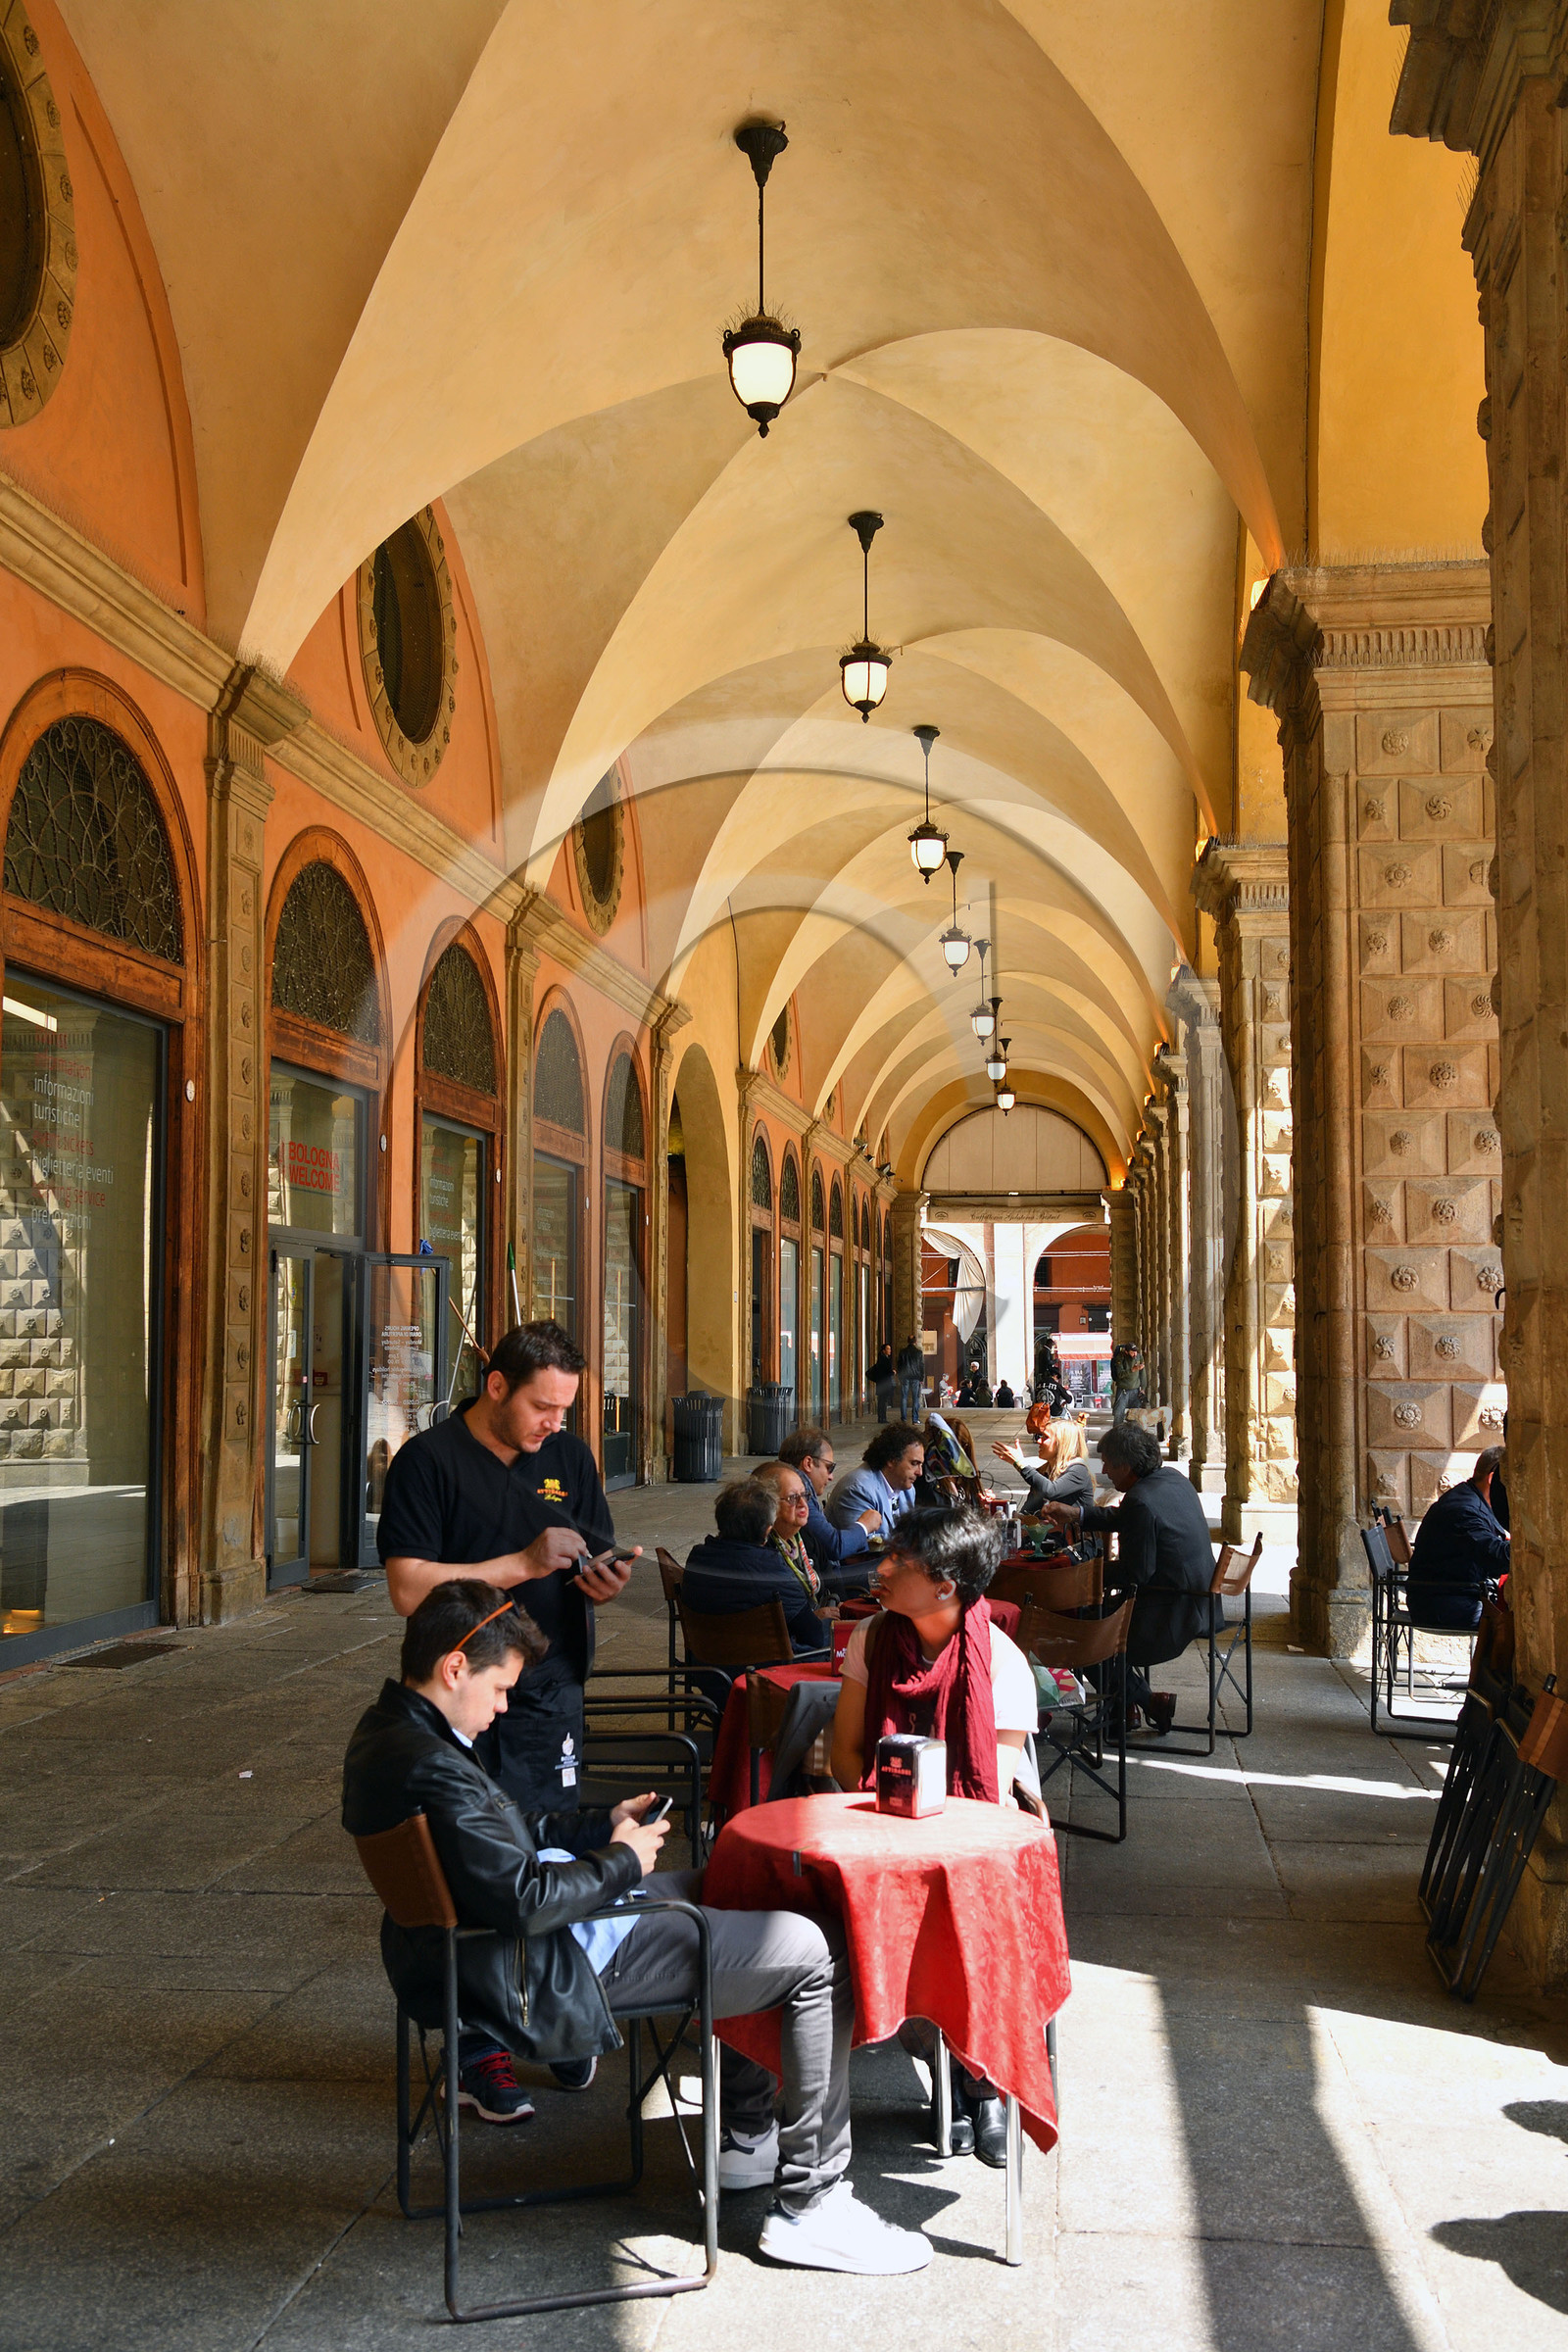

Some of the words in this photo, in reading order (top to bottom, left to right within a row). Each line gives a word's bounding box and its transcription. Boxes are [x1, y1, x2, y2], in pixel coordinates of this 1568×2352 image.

[34, 1072, 94, 1105] informazioni
[33, 1100, 79, 1127] turistiche
[288, 1141, 340, 1171] BOLOGNA
[85, 1165, 114, 1184] eventi
[289, 1163, 341, 1193] WELCOME
